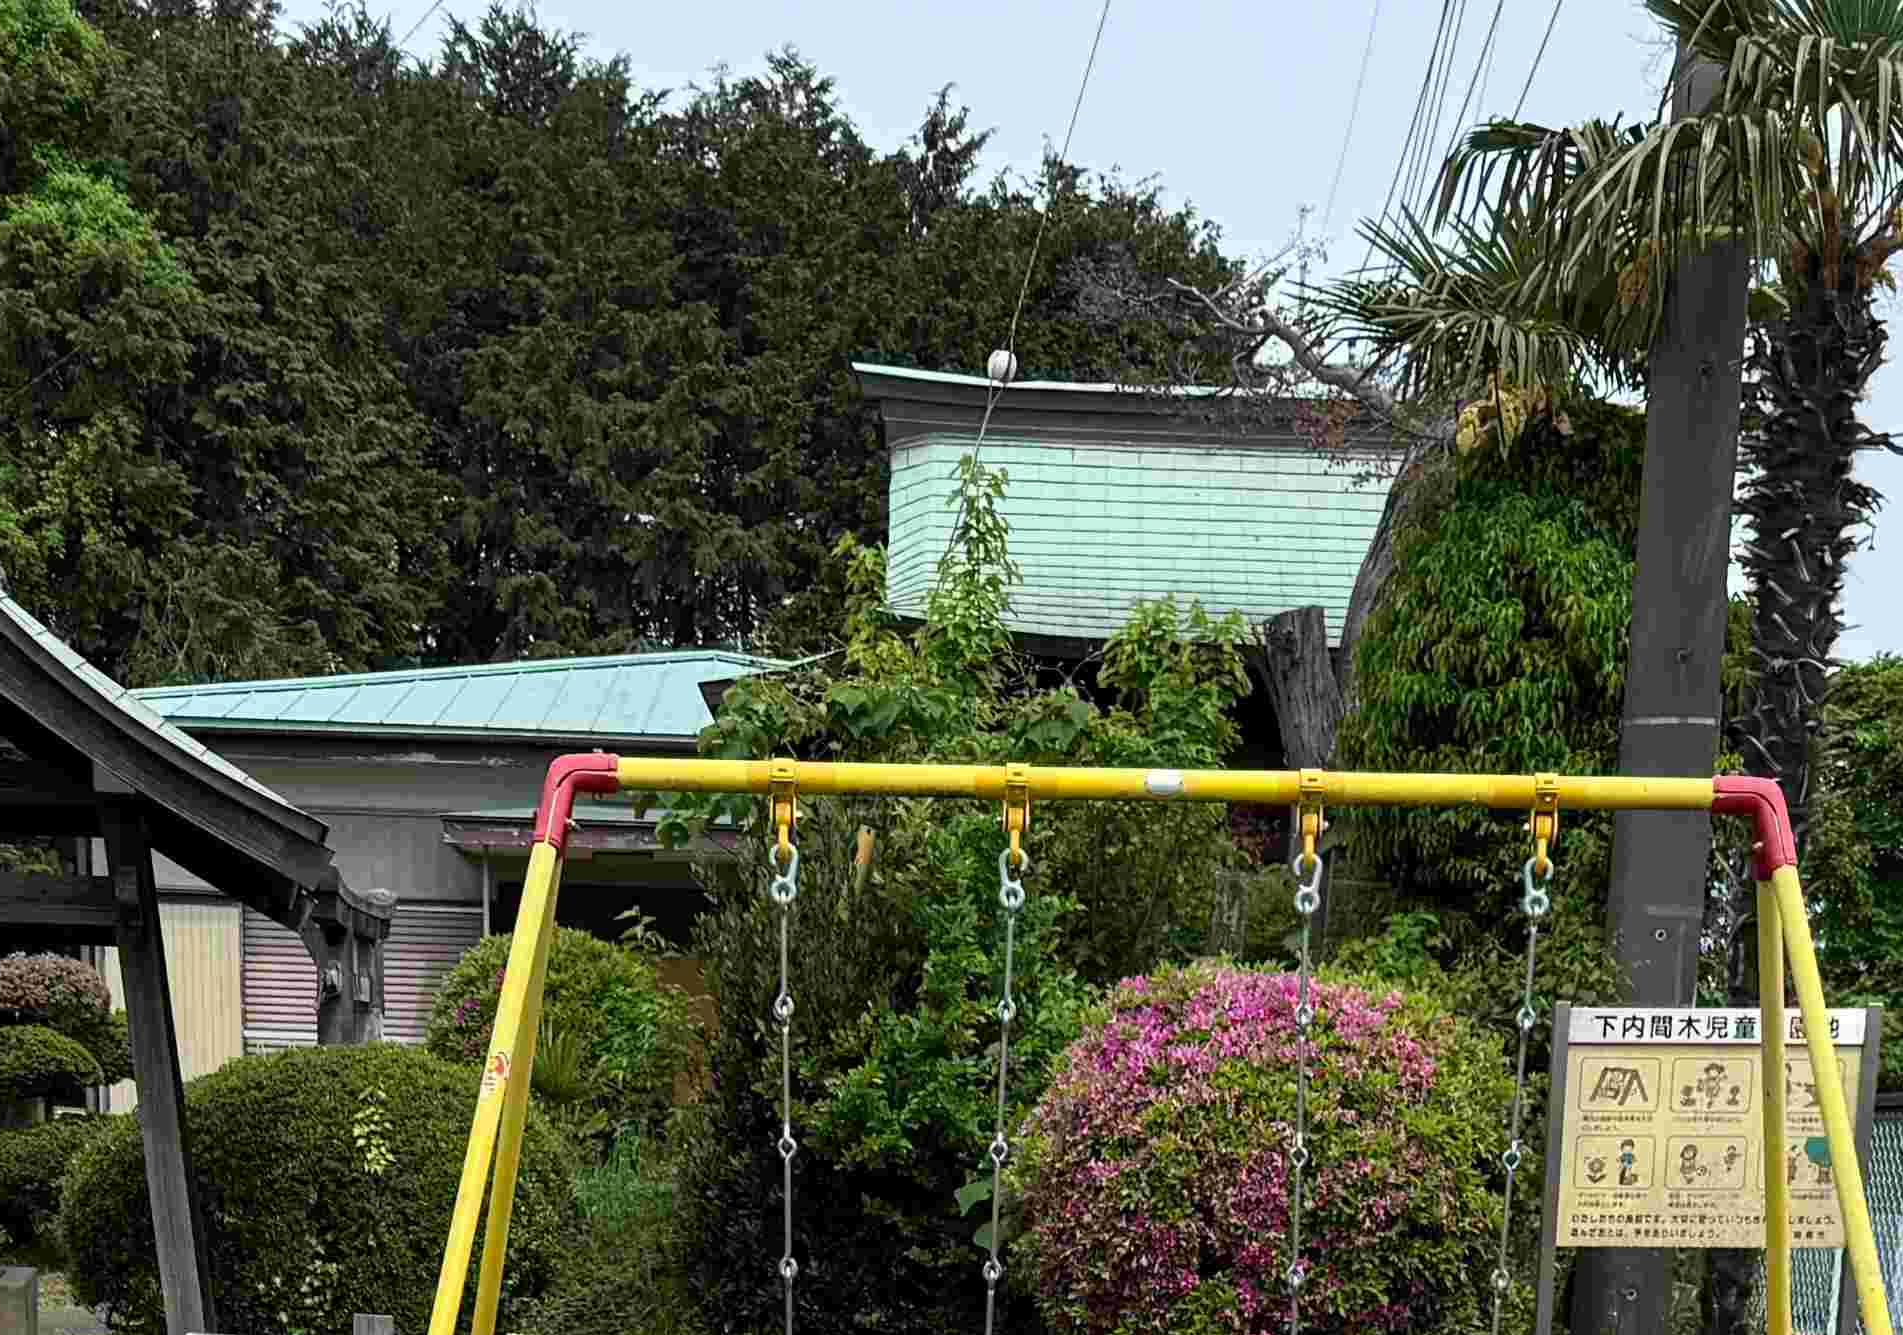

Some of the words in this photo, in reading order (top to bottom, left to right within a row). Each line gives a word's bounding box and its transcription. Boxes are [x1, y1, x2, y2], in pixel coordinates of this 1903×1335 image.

[1594, 1014, 1840, 1041] 下内間木児童園
